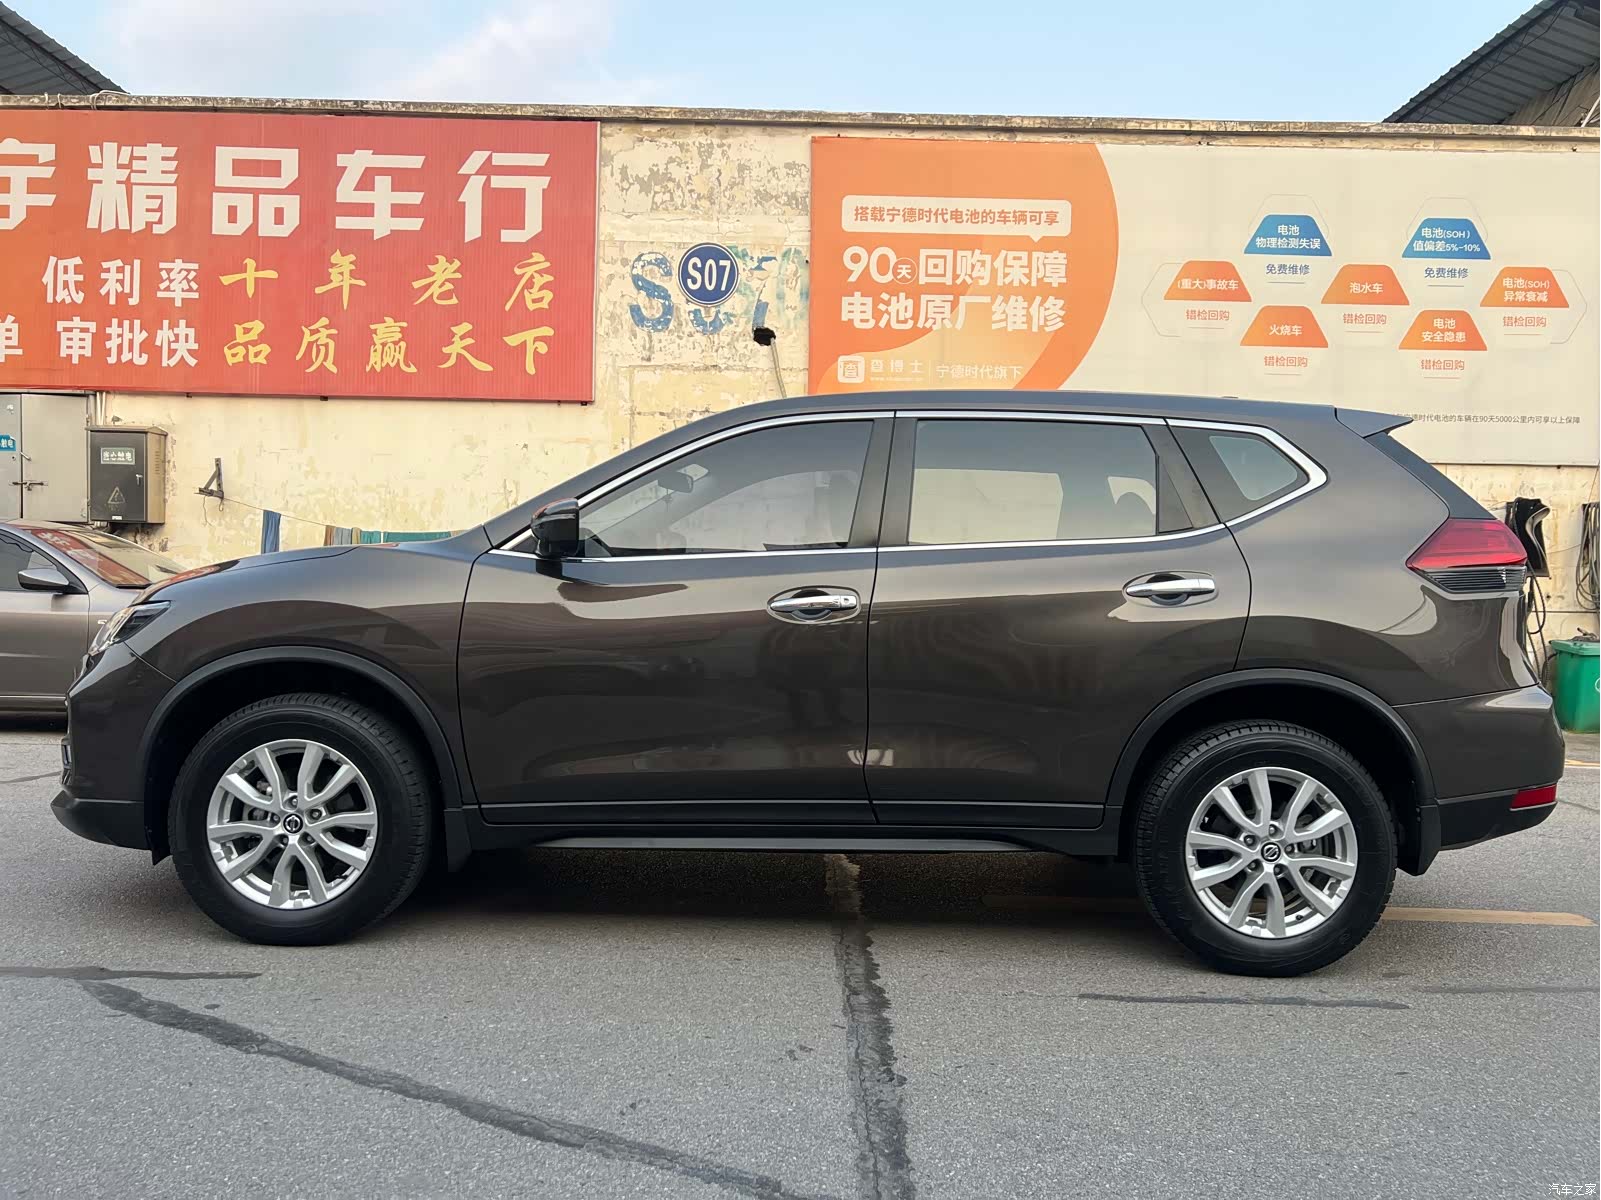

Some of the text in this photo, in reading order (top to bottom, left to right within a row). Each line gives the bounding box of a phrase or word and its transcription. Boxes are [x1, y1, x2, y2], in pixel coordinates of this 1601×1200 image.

[0, 137, 552, 244] 宇精品车行
[854, 206, 1059, 226] 搭载宁德时代电池的车辆可享
[1277, 224, 1299, 236] 电池
[1255, 237, 1321, 250] 物理检测失误
[842, 245, 1067, 287] 90天回购保障
[1266, 264, 1310, 276] 免费维修
[687, 256, 731, 291] S07
[1424, 267, 1469, 279] 免费维修
[42, 255, 200, 306] 低利率
[218, 248, 554, 312] 十年老店
[1502, 276, 1550, 289] 电池(SOH)
[1349, 282, 1383, 294] 泡水车
[1503, 290, 1548, 303] 异常衰减
[841, 291, 1066, 333] 电池原厂维修
[1185, 309, 1230, 321] 错检回购
[1342, 312, 1387, 325] 错检回购
[1433, 317, 1456, 330] 电池
[1502, 316, 1547, 328] 错检回购
[1269, 324, 1302, 337] 火烧车
[1421, 331, 1467, 343] 安全隐患
[57, 316, 200, 367] 审批快
[223, 316, 554, 375] 品质赢天下
[1263, 356, 1308, 368] 错检回购
[1420, 359, 1465, 371] 错检回购
[936, 364, 1023, 380] 宁德时代旗下
